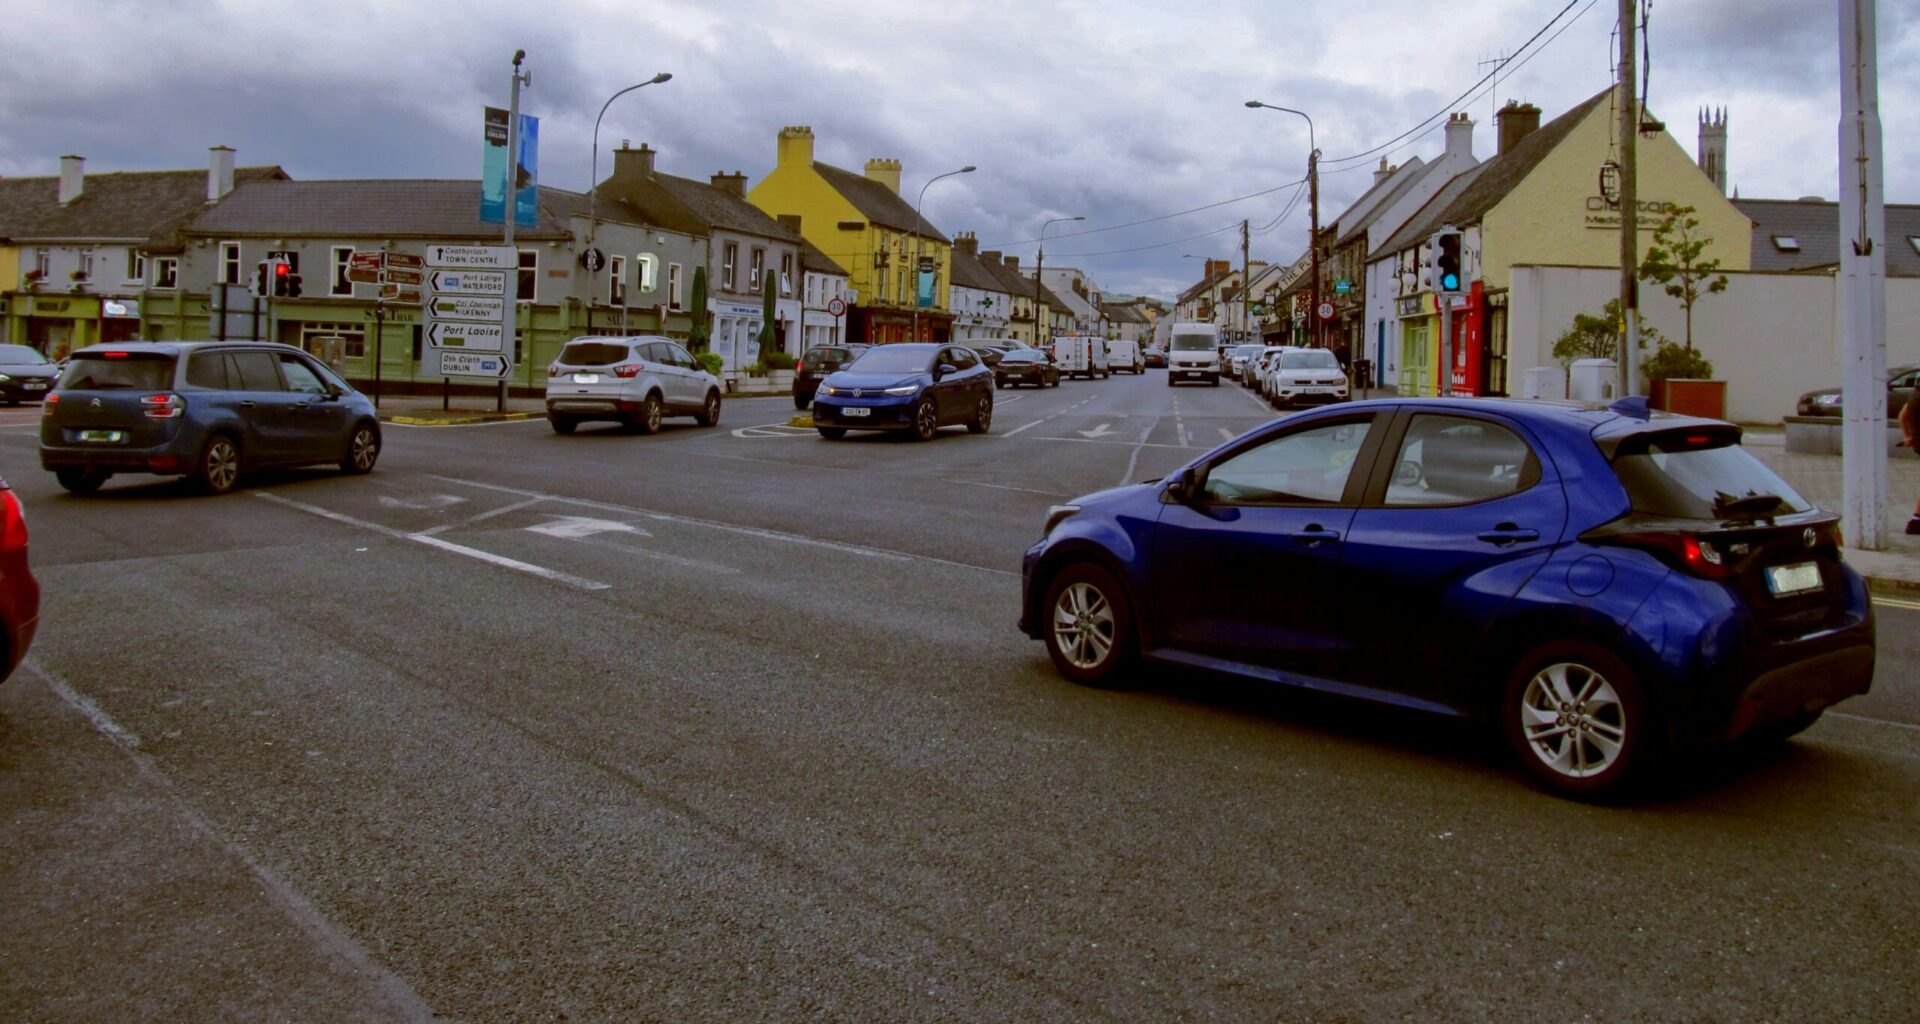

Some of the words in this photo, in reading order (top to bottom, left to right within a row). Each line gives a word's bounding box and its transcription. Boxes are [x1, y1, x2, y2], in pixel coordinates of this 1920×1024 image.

[1586, 196, 1674, 212] Claton
[470, 256, 498, 264] CENTRE
[1281, 269, 1299, 286] THE
[463, 283, 502, 291] WATERFORD
[832, 302, 841, 311] 30
[1321, 306, 1331, 315] 30
[455, 309, 491, 317] KILKENNY
[443, 325, 464, 335] Port
[468, 326, 500, 336] Laoise
[459, 355, 481, 363] Cliath
[443, 364, 470, 372] DUBLIN
